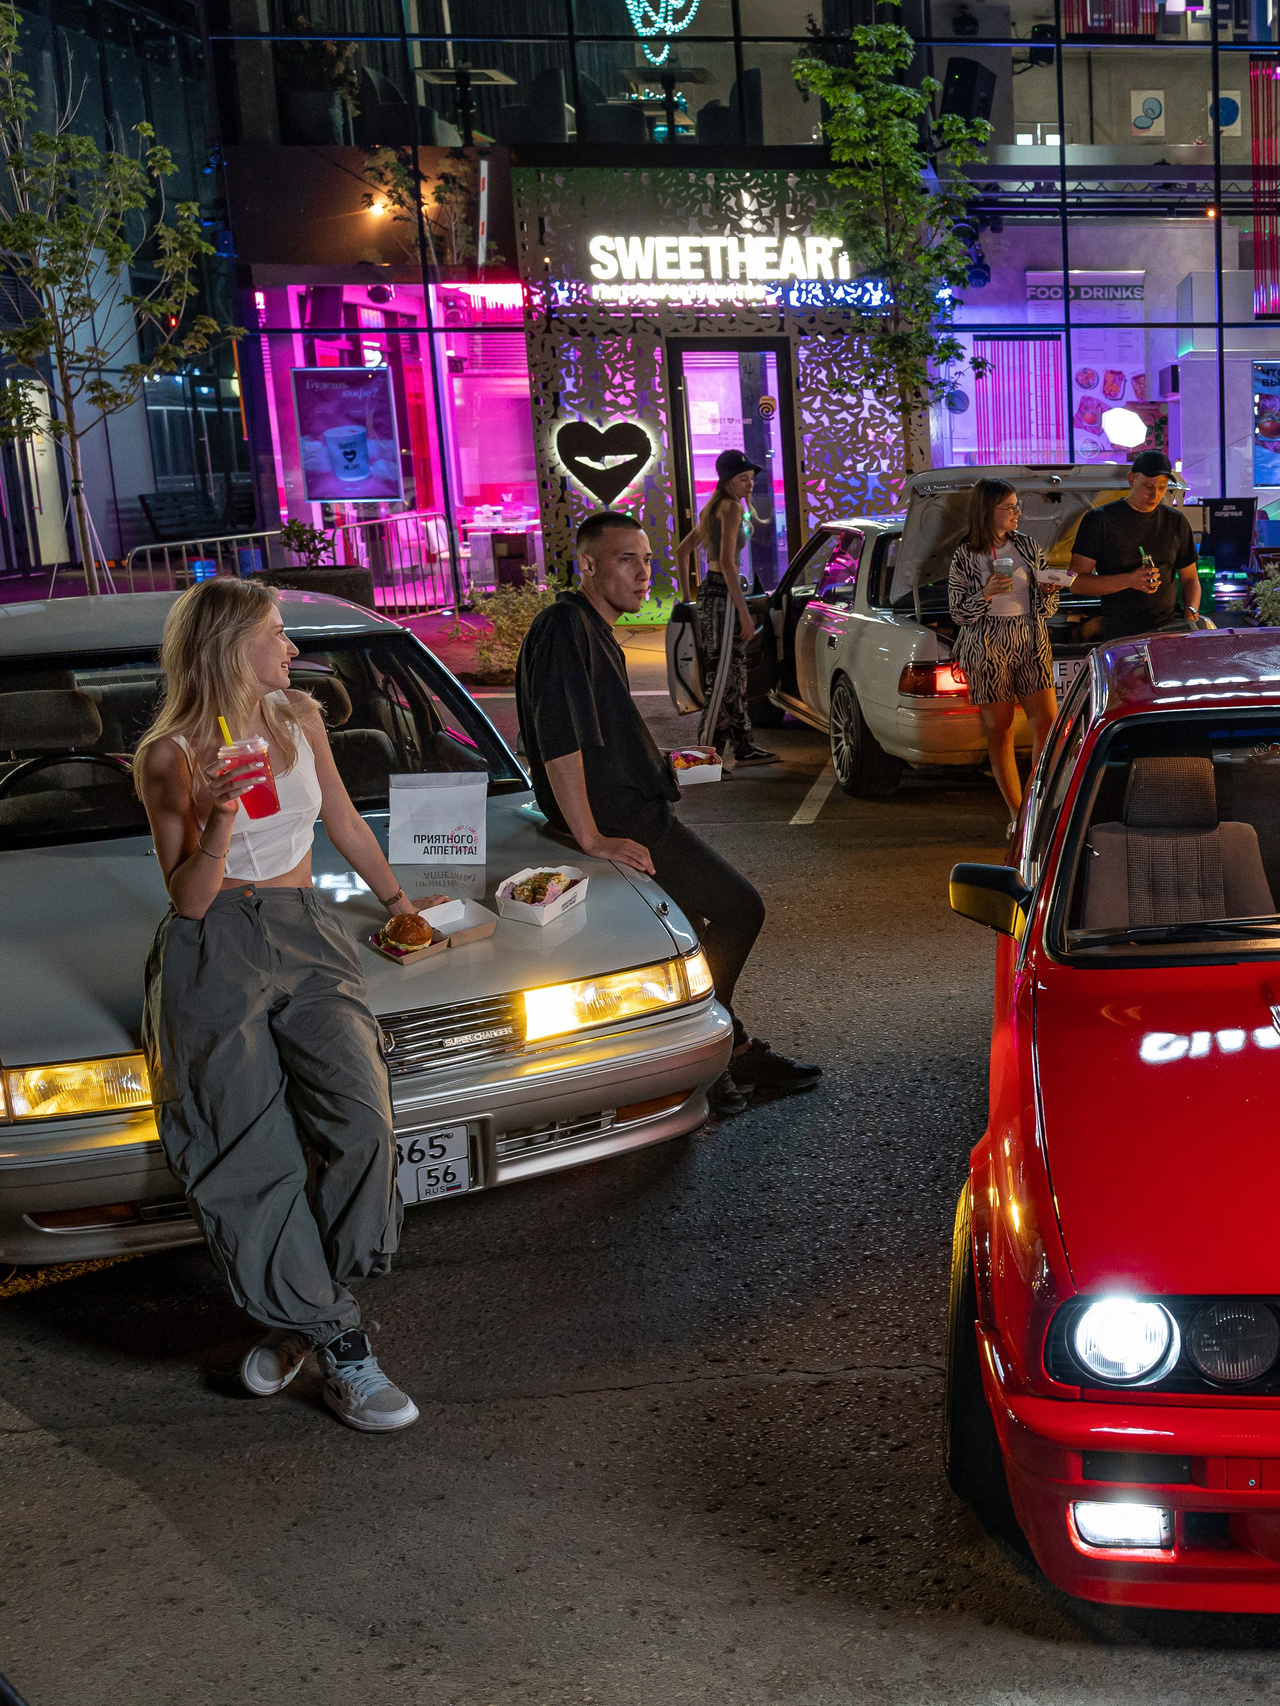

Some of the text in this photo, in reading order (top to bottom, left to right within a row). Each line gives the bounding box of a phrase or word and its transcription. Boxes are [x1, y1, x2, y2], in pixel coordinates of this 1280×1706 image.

[1080, 287, 1144, 299] DRINKS
[413, 834, 474, 845] ПРИЯТНОГО
[422, 845, 477, 855] АППЕТИТА!
[474, 1026, 513, 1042] CHARGER
[427, 1165, 457, 1187] 56
[425, 1185, 446, 1196] RUS
